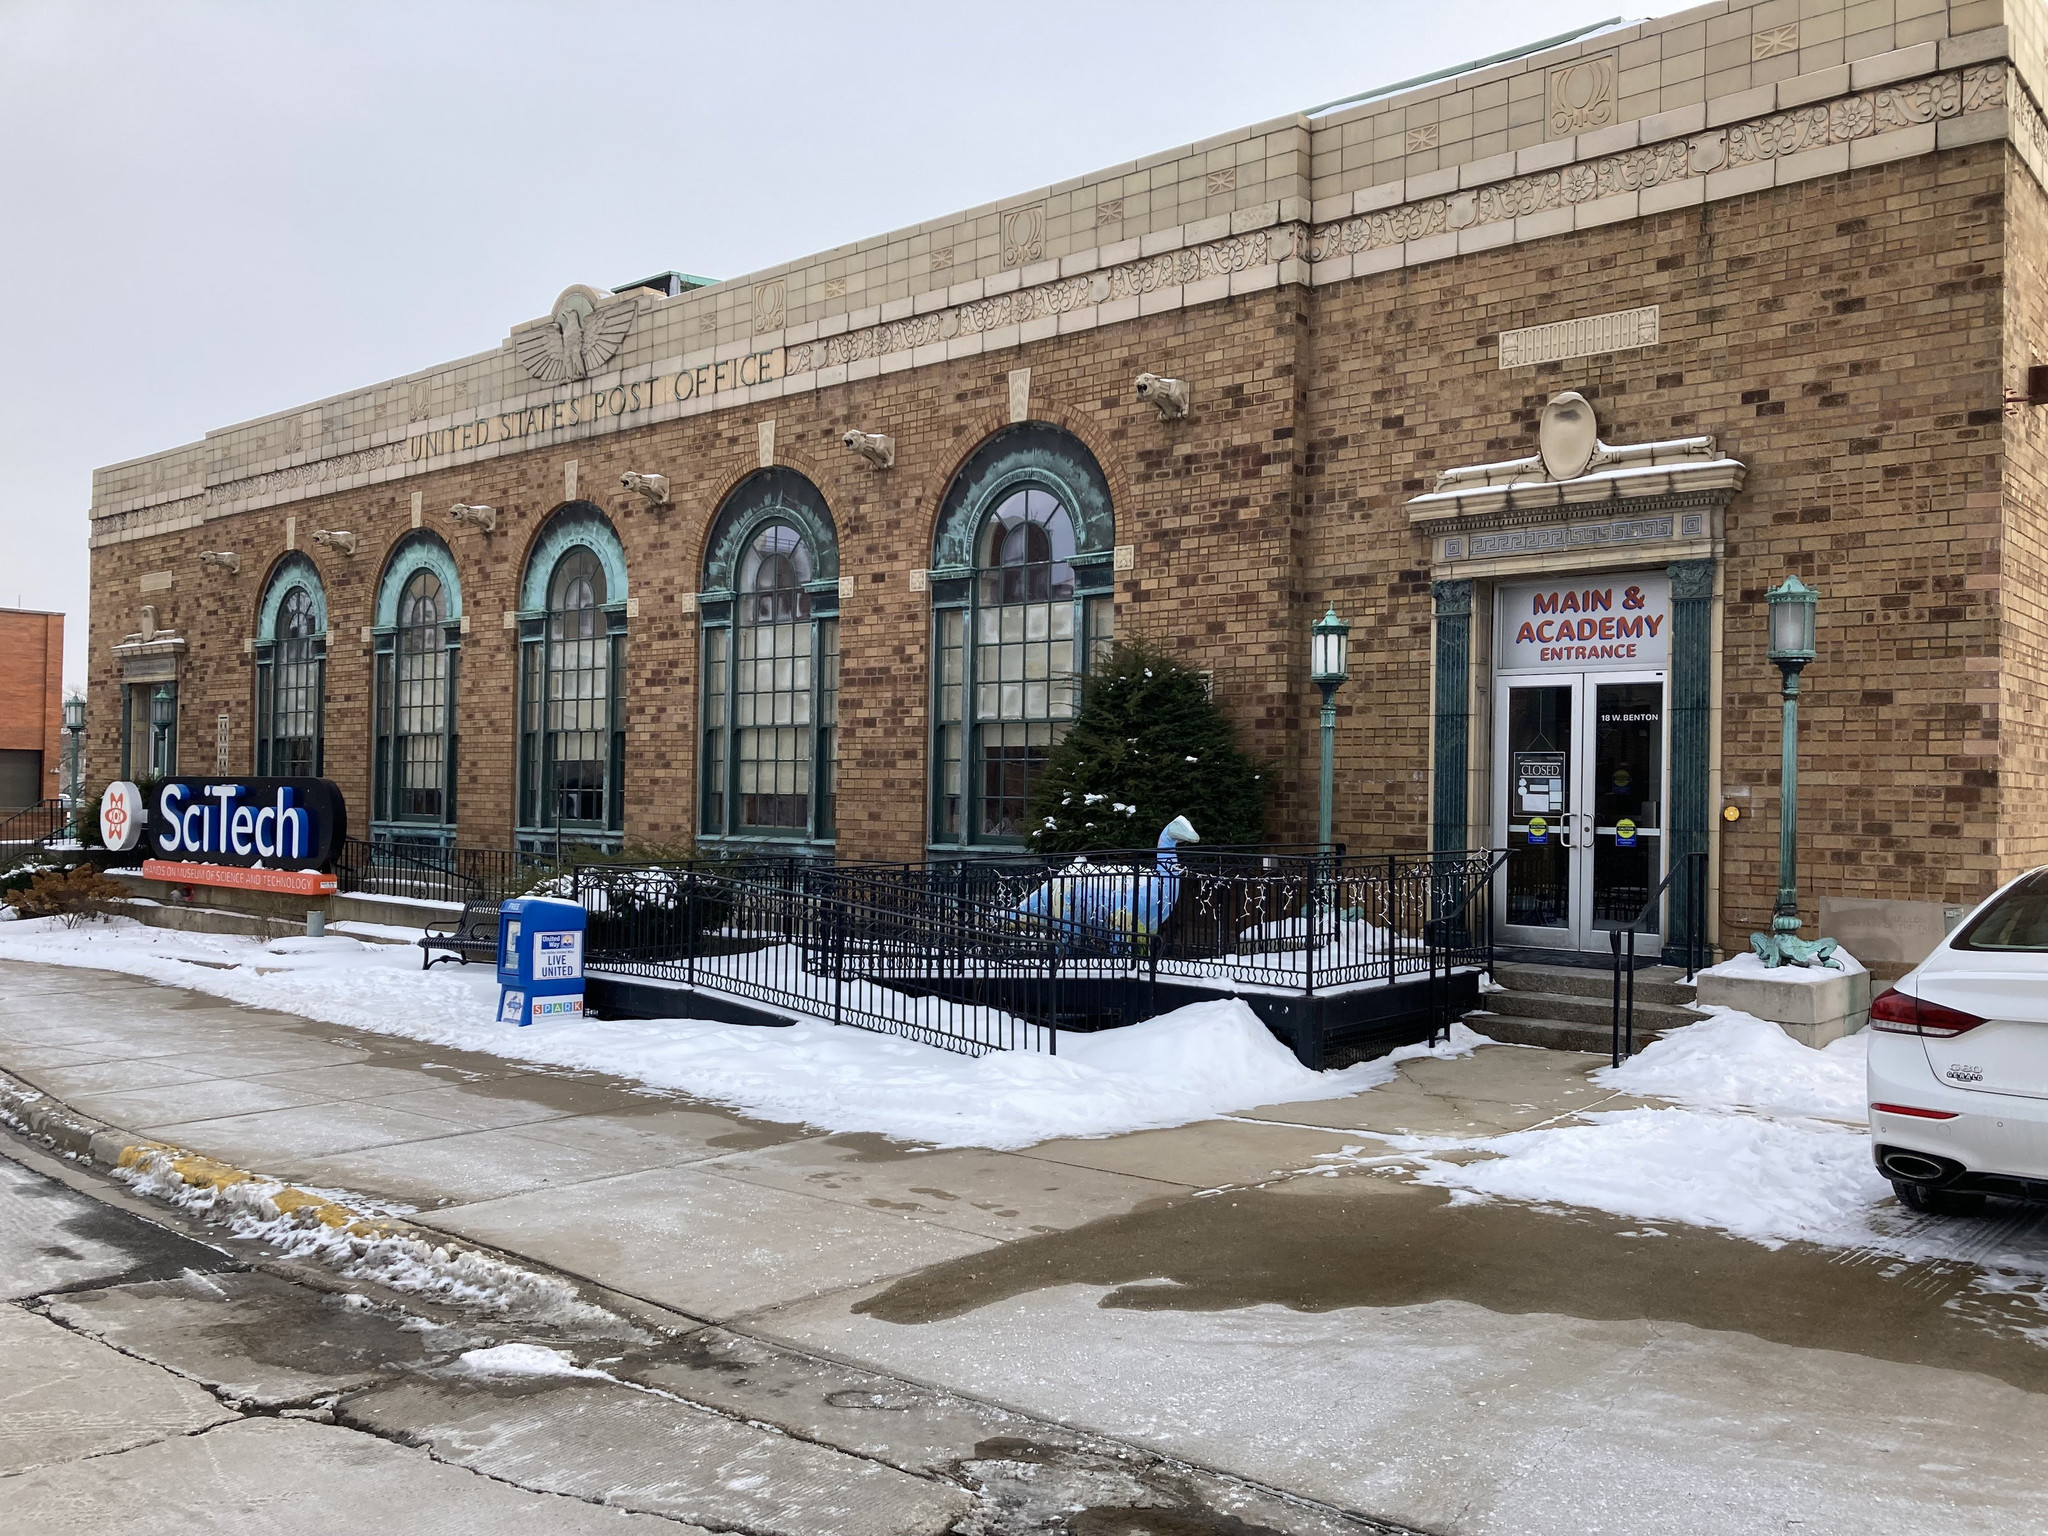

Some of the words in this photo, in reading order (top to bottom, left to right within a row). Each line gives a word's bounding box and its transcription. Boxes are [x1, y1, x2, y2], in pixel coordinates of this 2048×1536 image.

[410, 417, 489, 462] UNITED
[500, 397, 580, 441] STATES
[595, 376, 659, 422] POST
[674, 349, 774, 401] OFFICE
[1533, 588, 1612, 615] MAIN
[1622, 585, 1645, 610] &
[1515, 614, 1664, 644] ACADEMY
[1540, 643, 1637, 661] ENTRANCE
[1601, 714, 1610, 722] 18
[1623, 713, 1659, 722] BENTON
[1521, 765, 1560, 776] CLOSED
[159, 783, 306, 859] SciTech
[144, 865, 165, 876] HANDS
[167, 866, 176, 877] ON
[177, 866, 205, 879] MUSEUM
[206, 869, 215, 880] OF
[216, 871, 244, 884] SCIENCE
[246, 873, 260, 885] AND
[263, 875, 312, 890] TECHNOLOGY
[548, 955, 566, 965] LIVE
[542, 966, 573, 977] UNITED
[534, 1001, 582, 1014] SPARK
